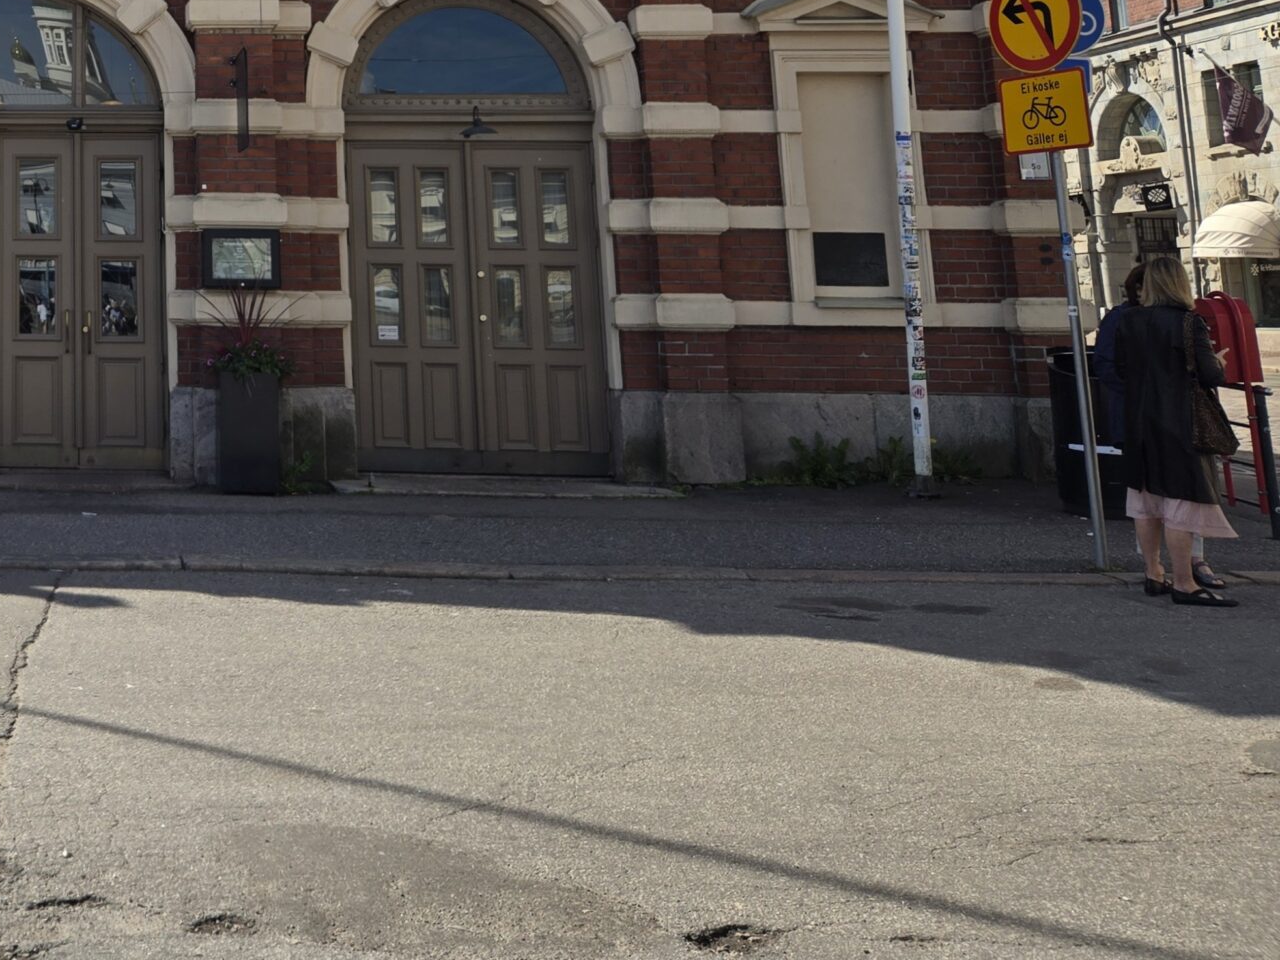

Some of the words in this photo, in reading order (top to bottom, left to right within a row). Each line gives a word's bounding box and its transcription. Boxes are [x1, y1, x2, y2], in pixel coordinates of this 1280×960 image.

[1020, 82, 1030, 94] Ei
[1032, 80, 1060, 92] koske
[1026, 133, 1055, 145] Gäller
[1058, 130, 1068, 144] ej
